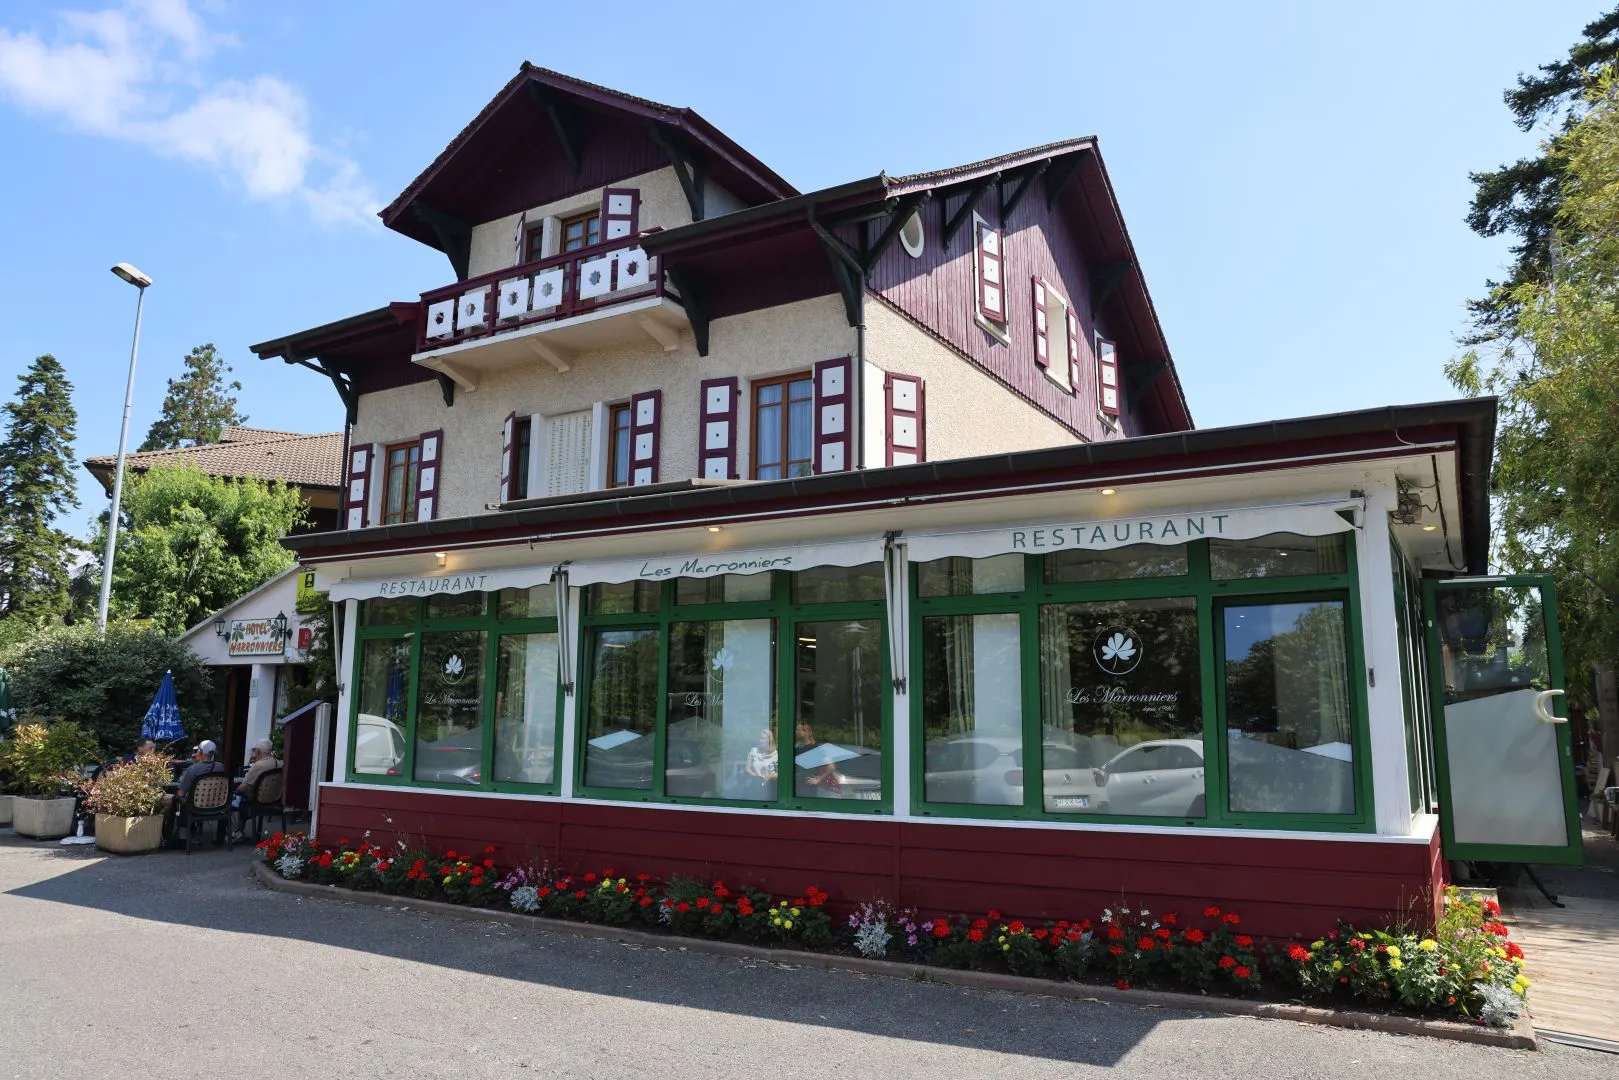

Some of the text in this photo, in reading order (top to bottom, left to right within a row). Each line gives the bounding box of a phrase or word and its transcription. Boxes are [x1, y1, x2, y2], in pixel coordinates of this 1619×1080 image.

[1012, 514, 1230, 549] RESTAURANT
[639, 556, 793, 577] Les Marronniers
[379, 575, 488, 595] RESTAURANT
[245, 622, 269, 636] HOTEL
[1066, 685, 1178, 704] Les Marronniers
